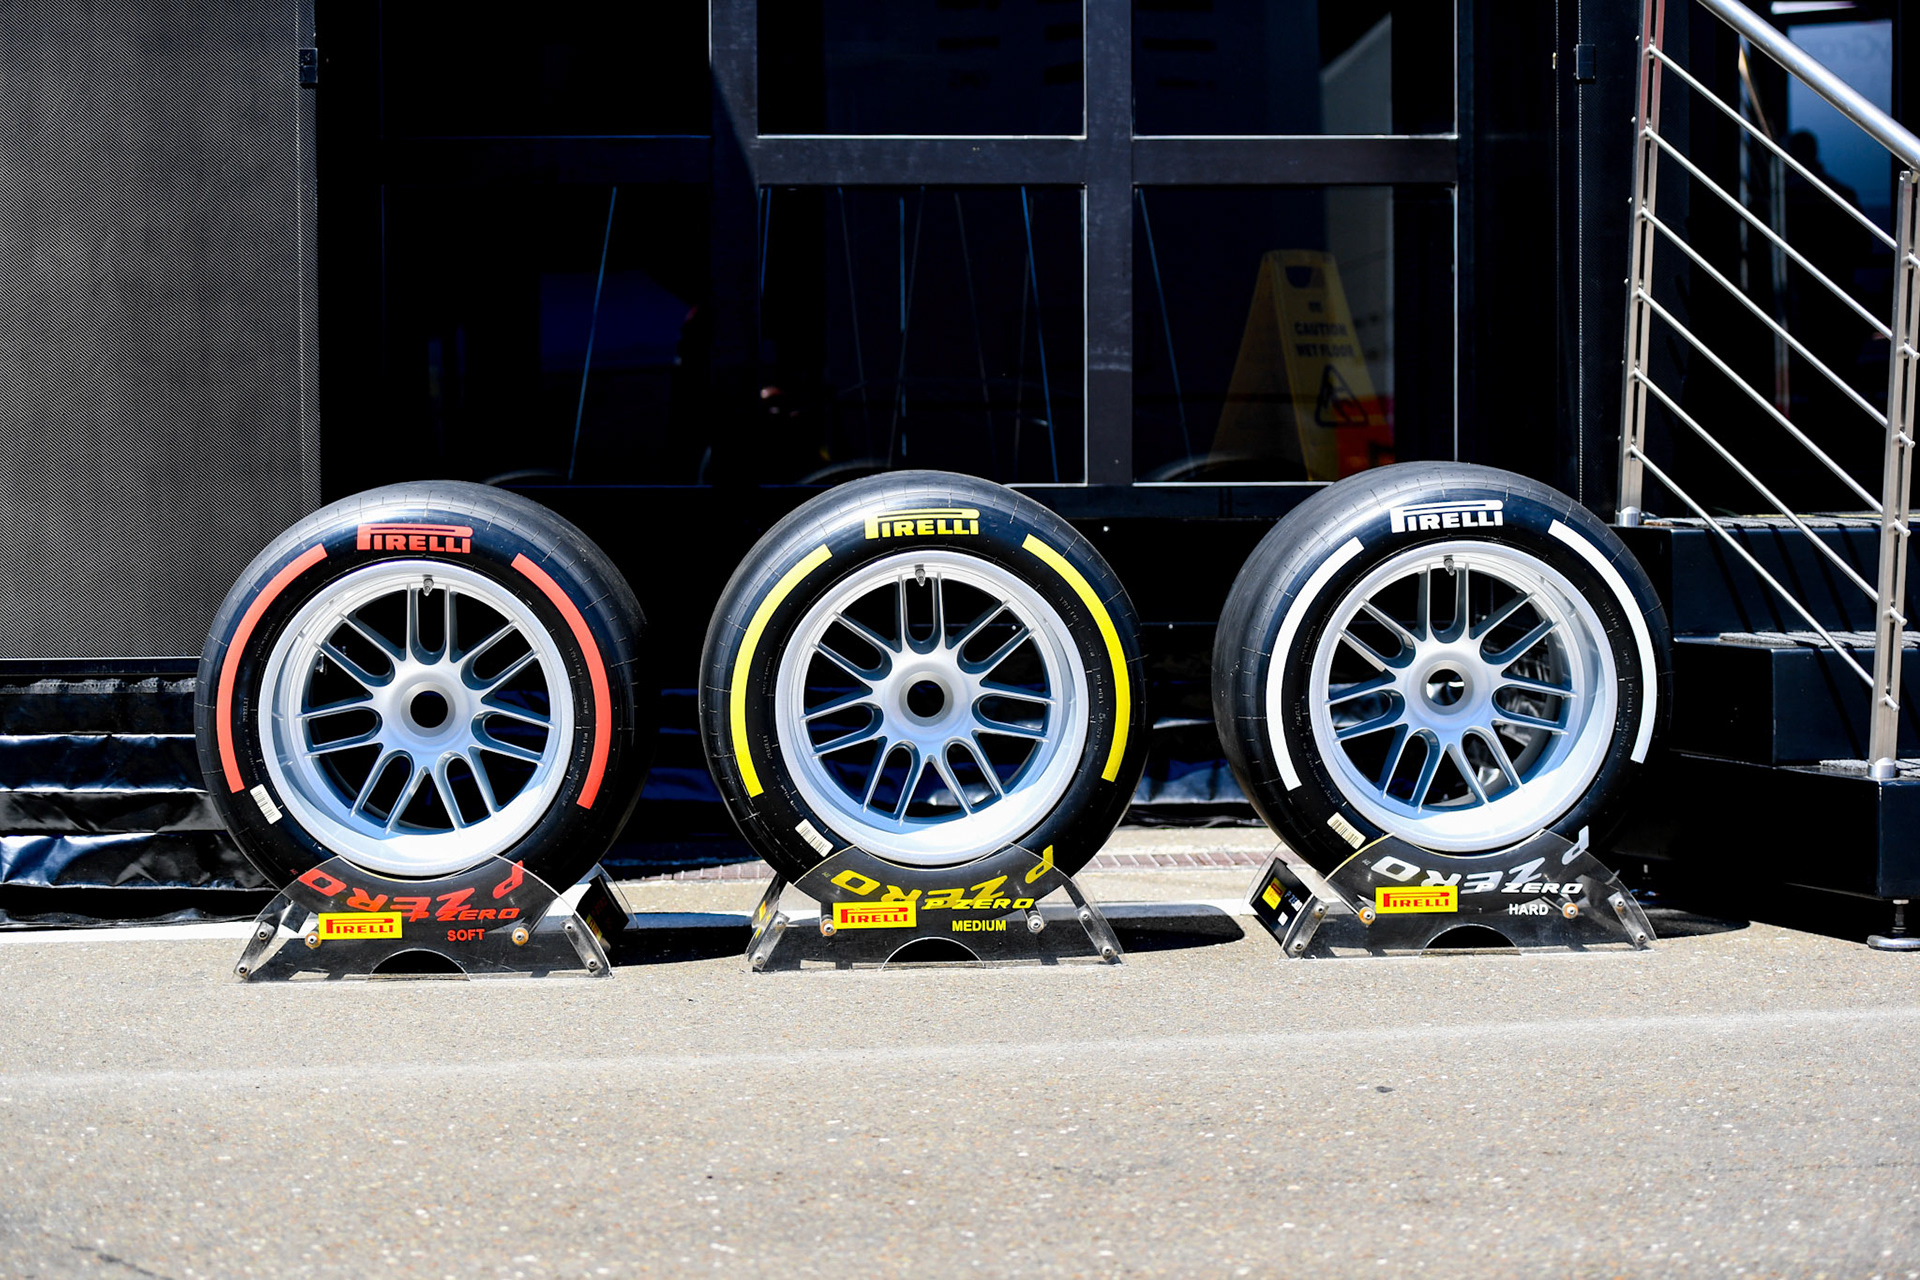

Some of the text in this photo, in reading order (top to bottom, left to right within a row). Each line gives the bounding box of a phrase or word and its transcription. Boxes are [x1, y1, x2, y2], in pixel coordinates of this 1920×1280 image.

[1294, 321, 1348, 336] CAUTION
[865, 508, 980, 540] PIRELLI
[1391, 500, 1504, 533] PIRELLI
[357, 524, 473, 553] PIRELLI
[1371, 825, 1589, 894] P ZERO
[831, 844, 1053, 909] P ZERO
[298, 861, 524, 918] P ZERO
[1501, 882, 1584, 894] ZERO
[952, 898, 1034, 909] ZERO
[1383, 892, 1450, 908] PIRELLI
[436, 907, 520, 922] ZERO
[840, 907, 909, 924] PIRELLI
[1508, 903, 1549, 915] HARD
[326, 918, 394, 934] PIRELLI
[952, 920, 1007, 932] MEDIUM
[447, 929, 486, 942] SOFT
